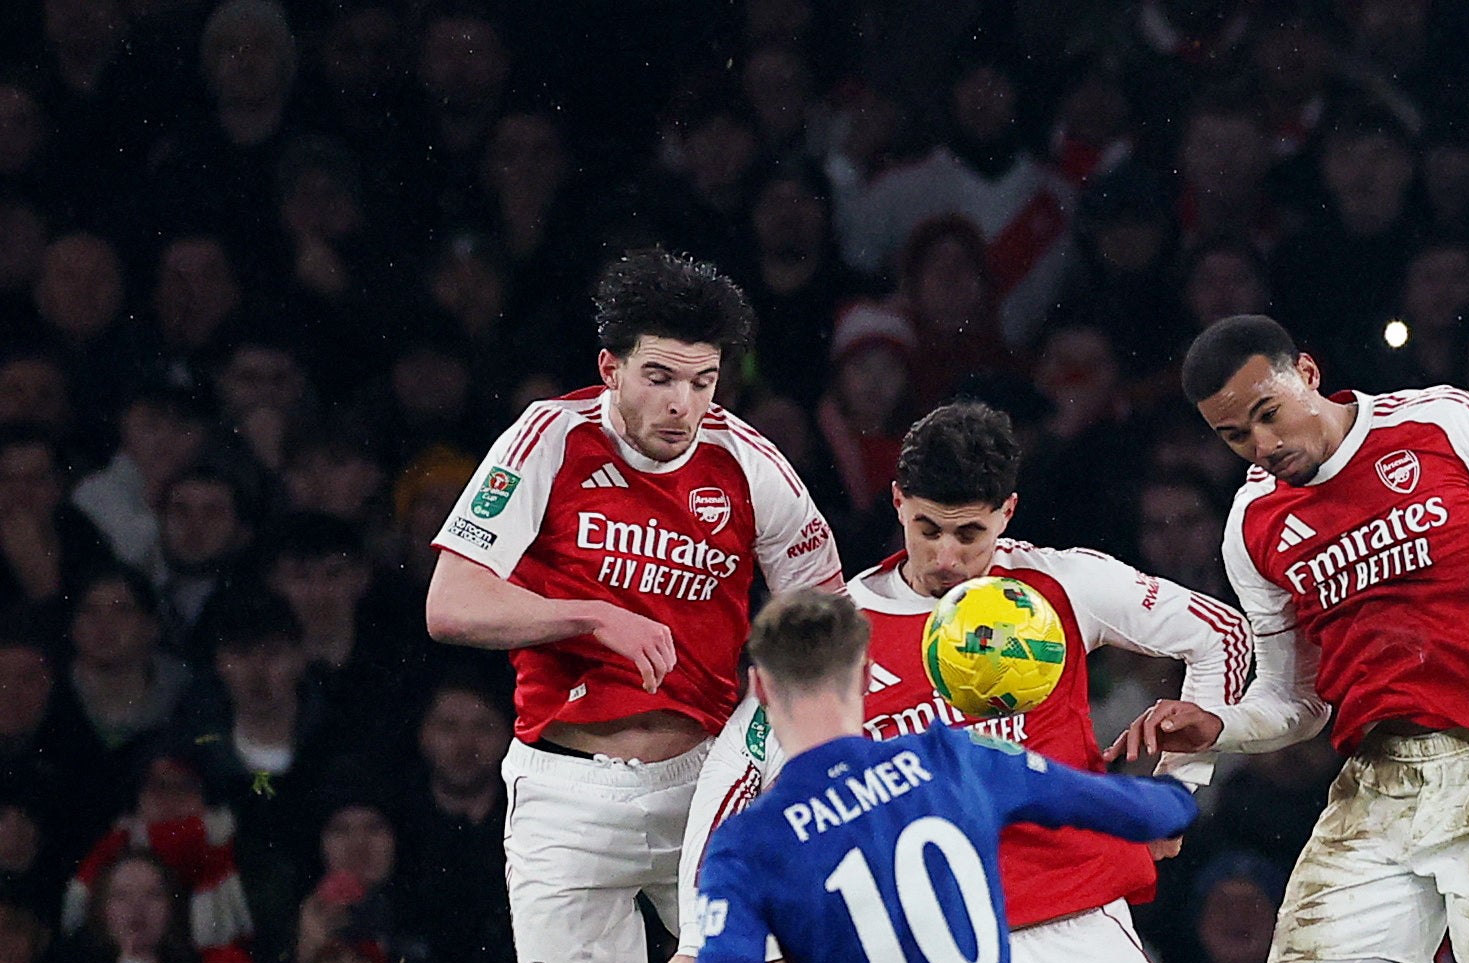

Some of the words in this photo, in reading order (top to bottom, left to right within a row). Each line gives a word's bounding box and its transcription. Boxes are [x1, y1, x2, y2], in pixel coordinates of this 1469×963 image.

[577, 511, 740, 579] Emirates
[597, 556, 638, 590] FLY
[638, 562, 719, 601] BETTER
[1285, 496, 1448, 595] Emirates
[1317, 571, 1349, 610] FLY
[1355, 537, 1433, 592] BETTER
[783, 750, 933, 843] PALMER
